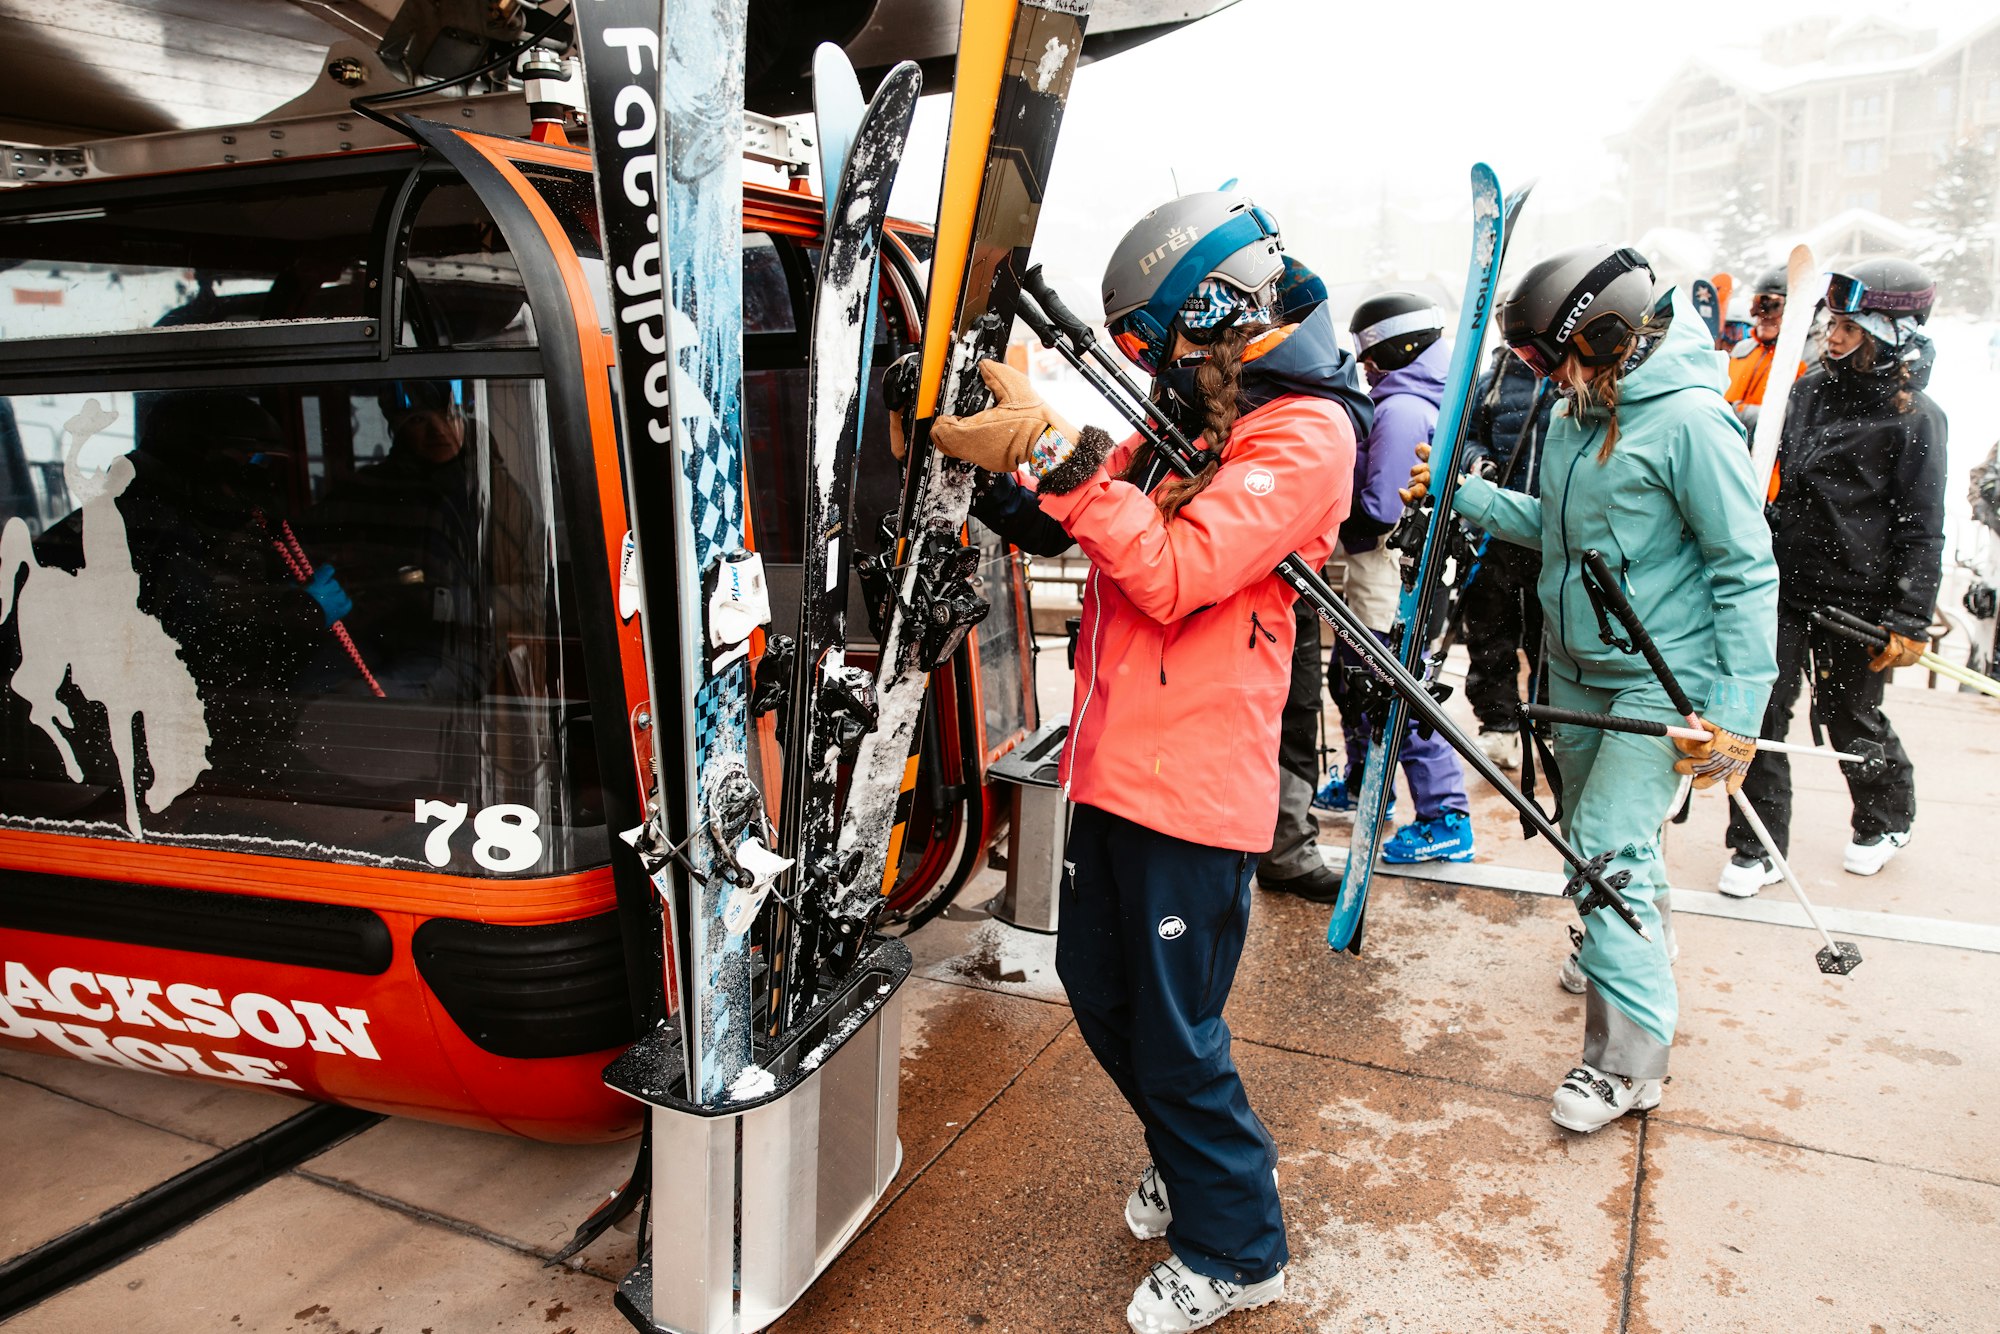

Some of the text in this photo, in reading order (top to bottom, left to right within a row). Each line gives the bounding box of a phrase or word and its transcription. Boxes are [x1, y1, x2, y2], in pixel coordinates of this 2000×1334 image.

[1556, 291, 1595, 344] GIRO
[1317, 607, 1396, 687] Carbon Graphite Composite
[414, 798, 543, 873] 78
[1414, 838, 1461, 855] SALOMON
[1188, 1302, 1234, 1327] AOMI
